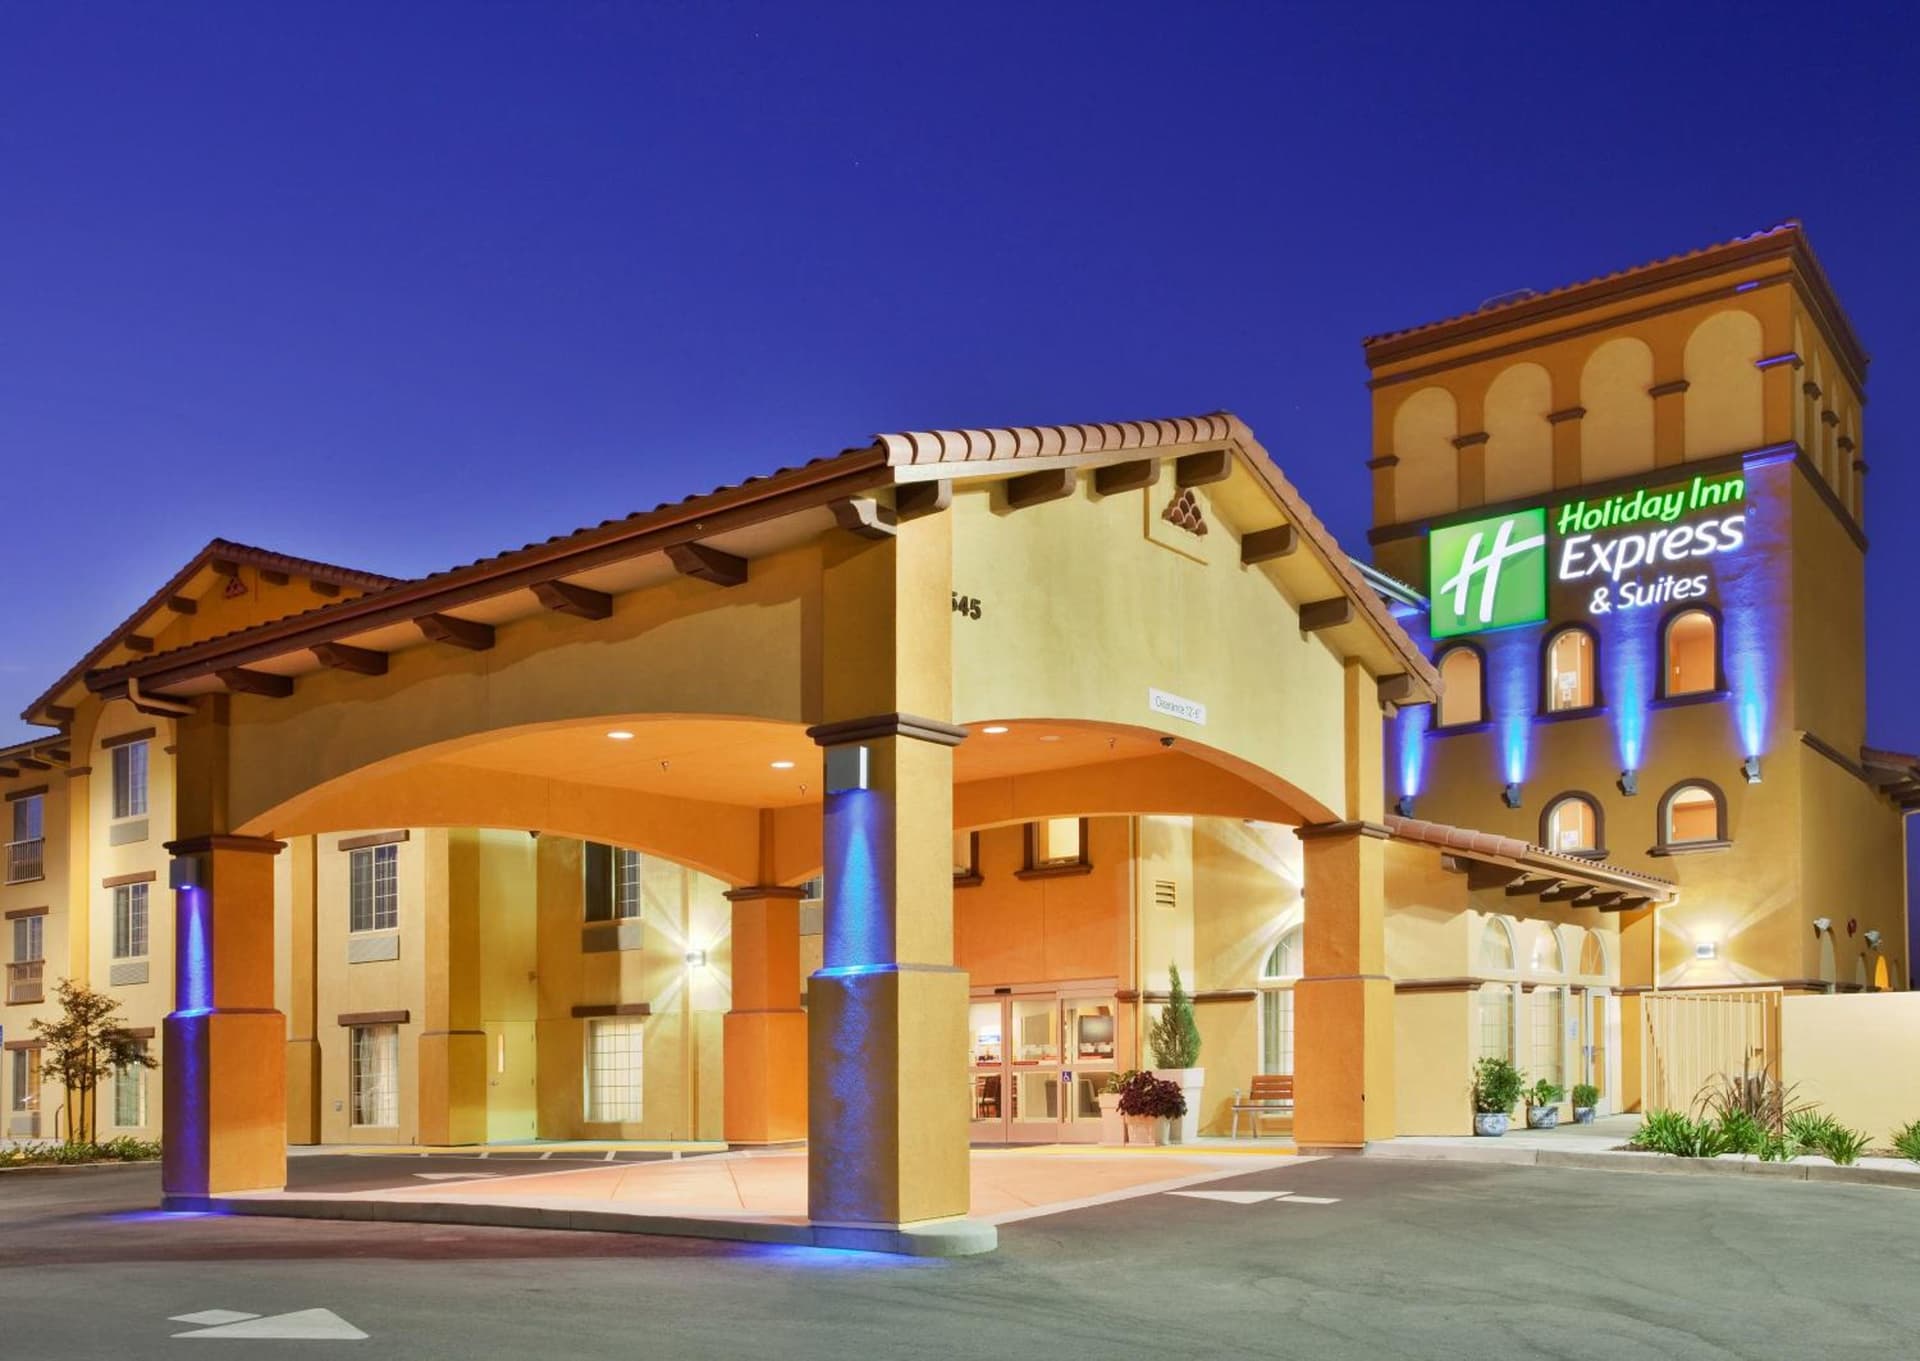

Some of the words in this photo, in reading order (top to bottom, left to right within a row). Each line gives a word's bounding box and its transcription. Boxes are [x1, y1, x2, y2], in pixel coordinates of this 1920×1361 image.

[1558, 489, 1684, 535] Holiday
[1689, 477, 1745, 509] Inn
[1559, 515, 1746, 582] Express
[1589, 587, 1612, 615] &
[1617, 574, 1707, 610] Suites
